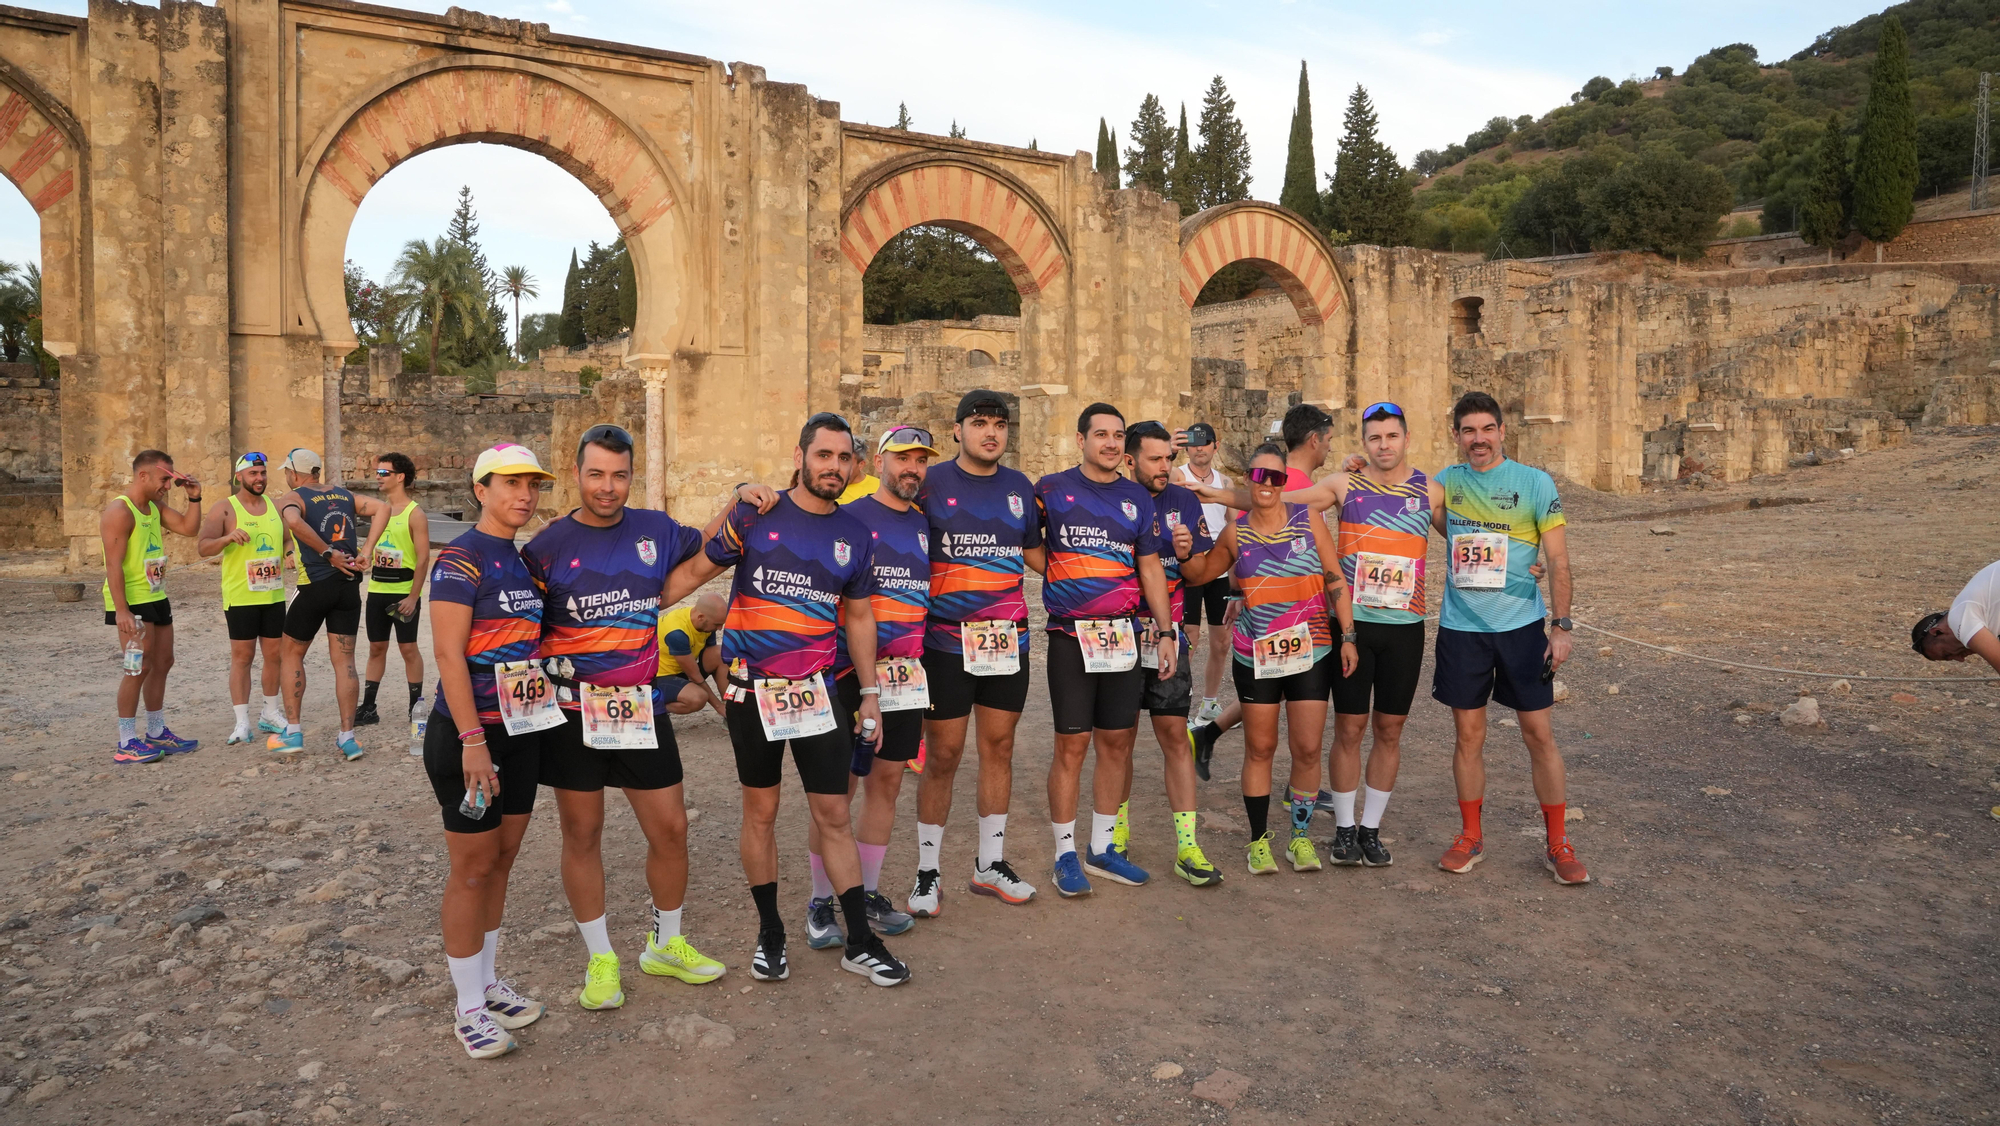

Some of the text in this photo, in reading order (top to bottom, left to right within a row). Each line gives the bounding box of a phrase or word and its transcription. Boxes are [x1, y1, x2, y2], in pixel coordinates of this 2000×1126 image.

[1069, 526, 1108, 539] TIENDA
[1449, 519, 1512, 531] TALLERES MODEL
[953, 534, 997, 544] TIENDA
[1071, 537, 1134, 553] CARPFSHING
[1461, 547, 1493, 563] 351
[256, 566, 277, 577] 491
[766, 569, 811, 587] TIENDA
[873, 566, 910, 578] TIENDA
[1368, 567, 1403, 586] 464
[508, 590, 534, 600] TIENDA
[579, 588, 630, 608] TIENDA
[977, 633, 1009, 650] 238
[1098, 632, 1119, 647] 54
[1268, 638, 1301, 656] 199
[887, 666, 909, 683] 18
[513, 677, 545, 701] 463
[775, 690, 815, 712] 500
[607, 700, 633, 719] 68
